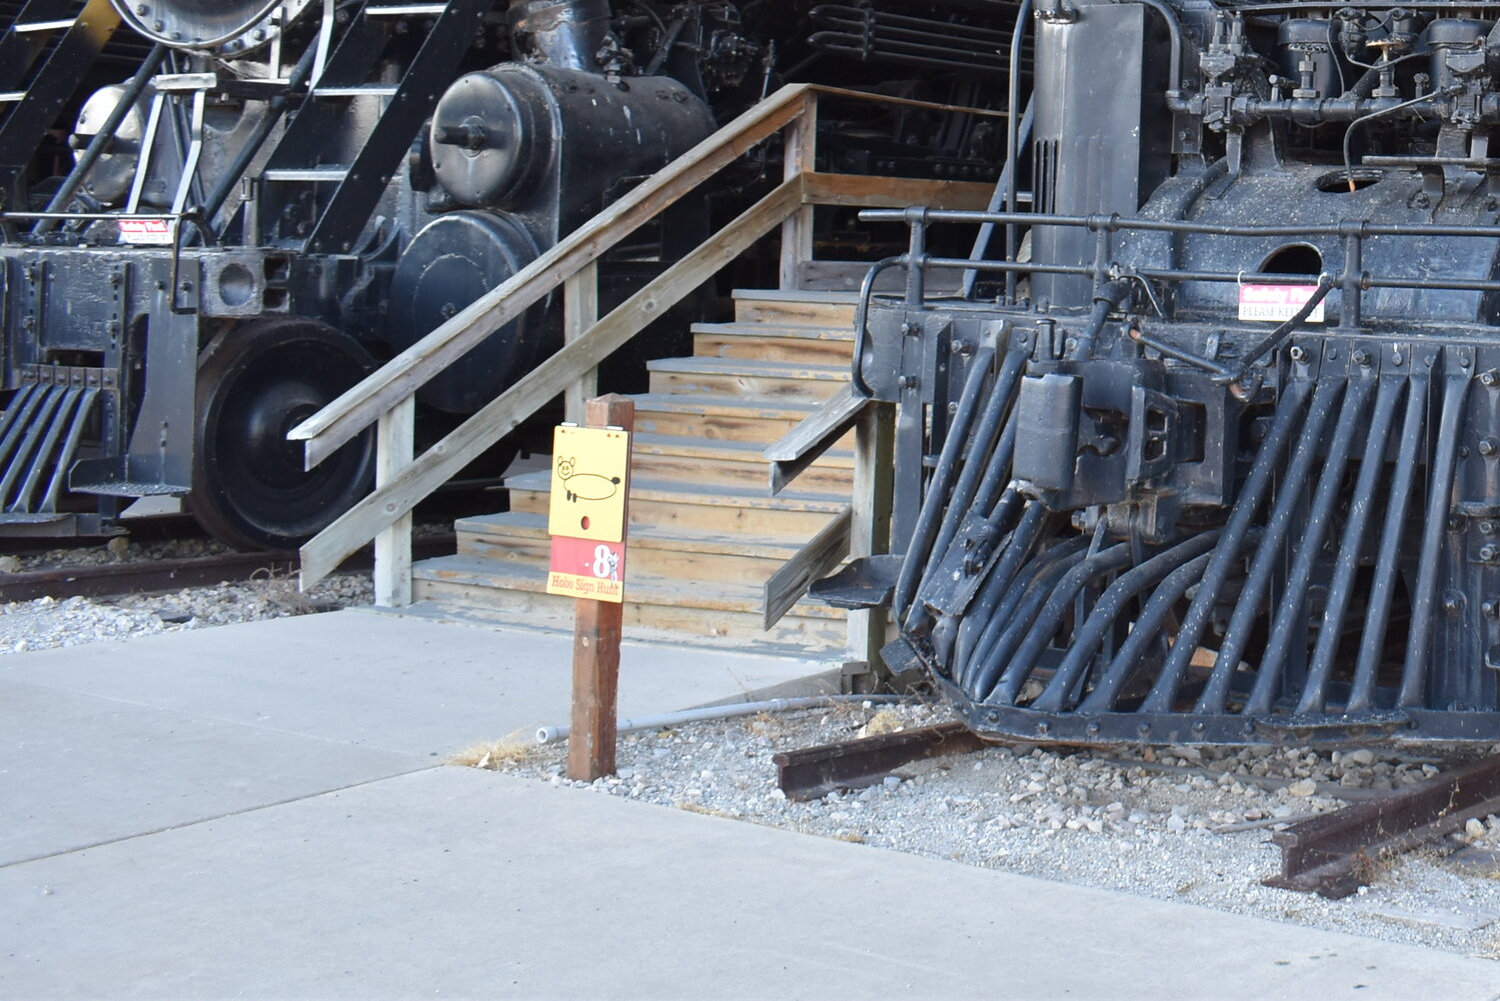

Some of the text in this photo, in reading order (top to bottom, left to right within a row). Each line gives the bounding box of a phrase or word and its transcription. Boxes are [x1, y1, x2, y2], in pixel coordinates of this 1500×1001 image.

[1243, 286, 1289, 304] Safety
[1242, 306, 1275, 317] PLEASE
[592, 544, 611, 578] 8
[551, 575, 619, 596] Hobo Sign Hunt
